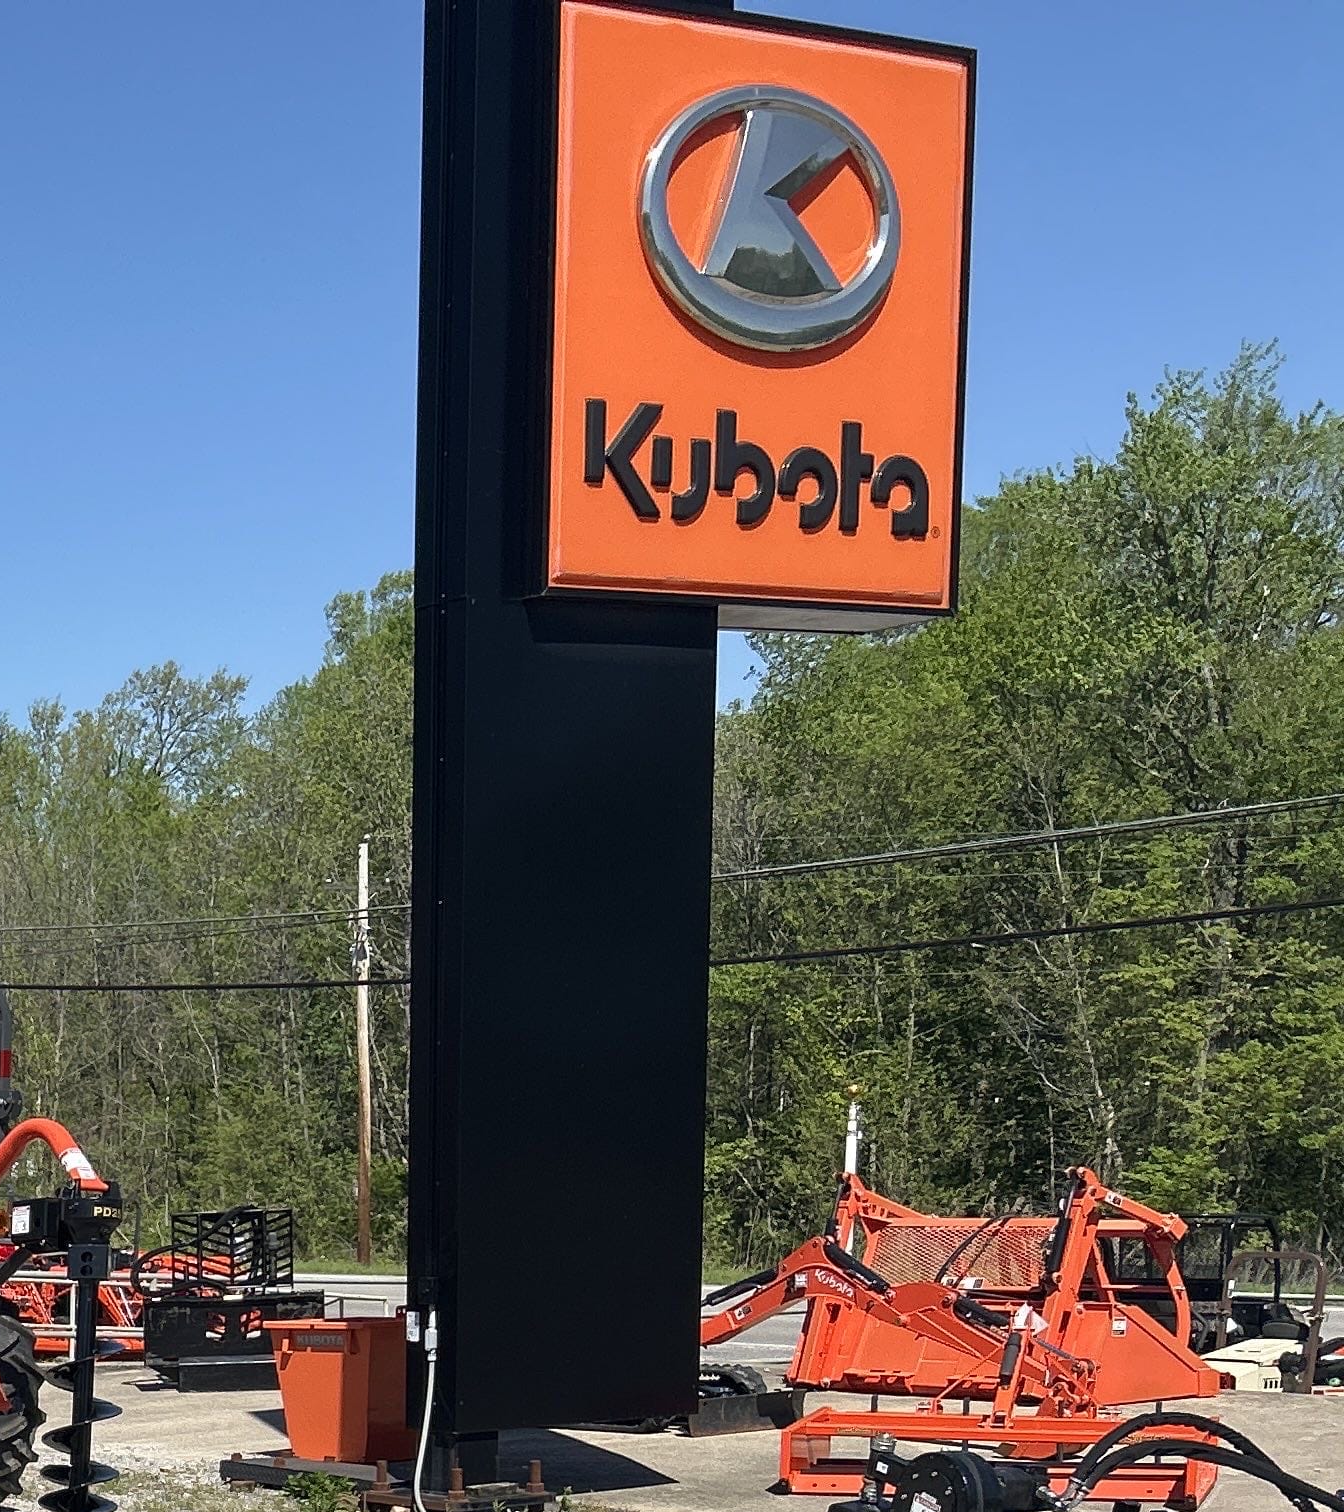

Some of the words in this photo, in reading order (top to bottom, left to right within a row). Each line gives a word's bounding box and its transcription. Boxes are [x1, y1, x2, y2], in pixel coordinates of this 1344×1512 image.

[584, 398, 931, 540] Kubota
[814, 1268, 854, 1297] Kubota
[296, 1333, 344, 1347] KUBOTA
